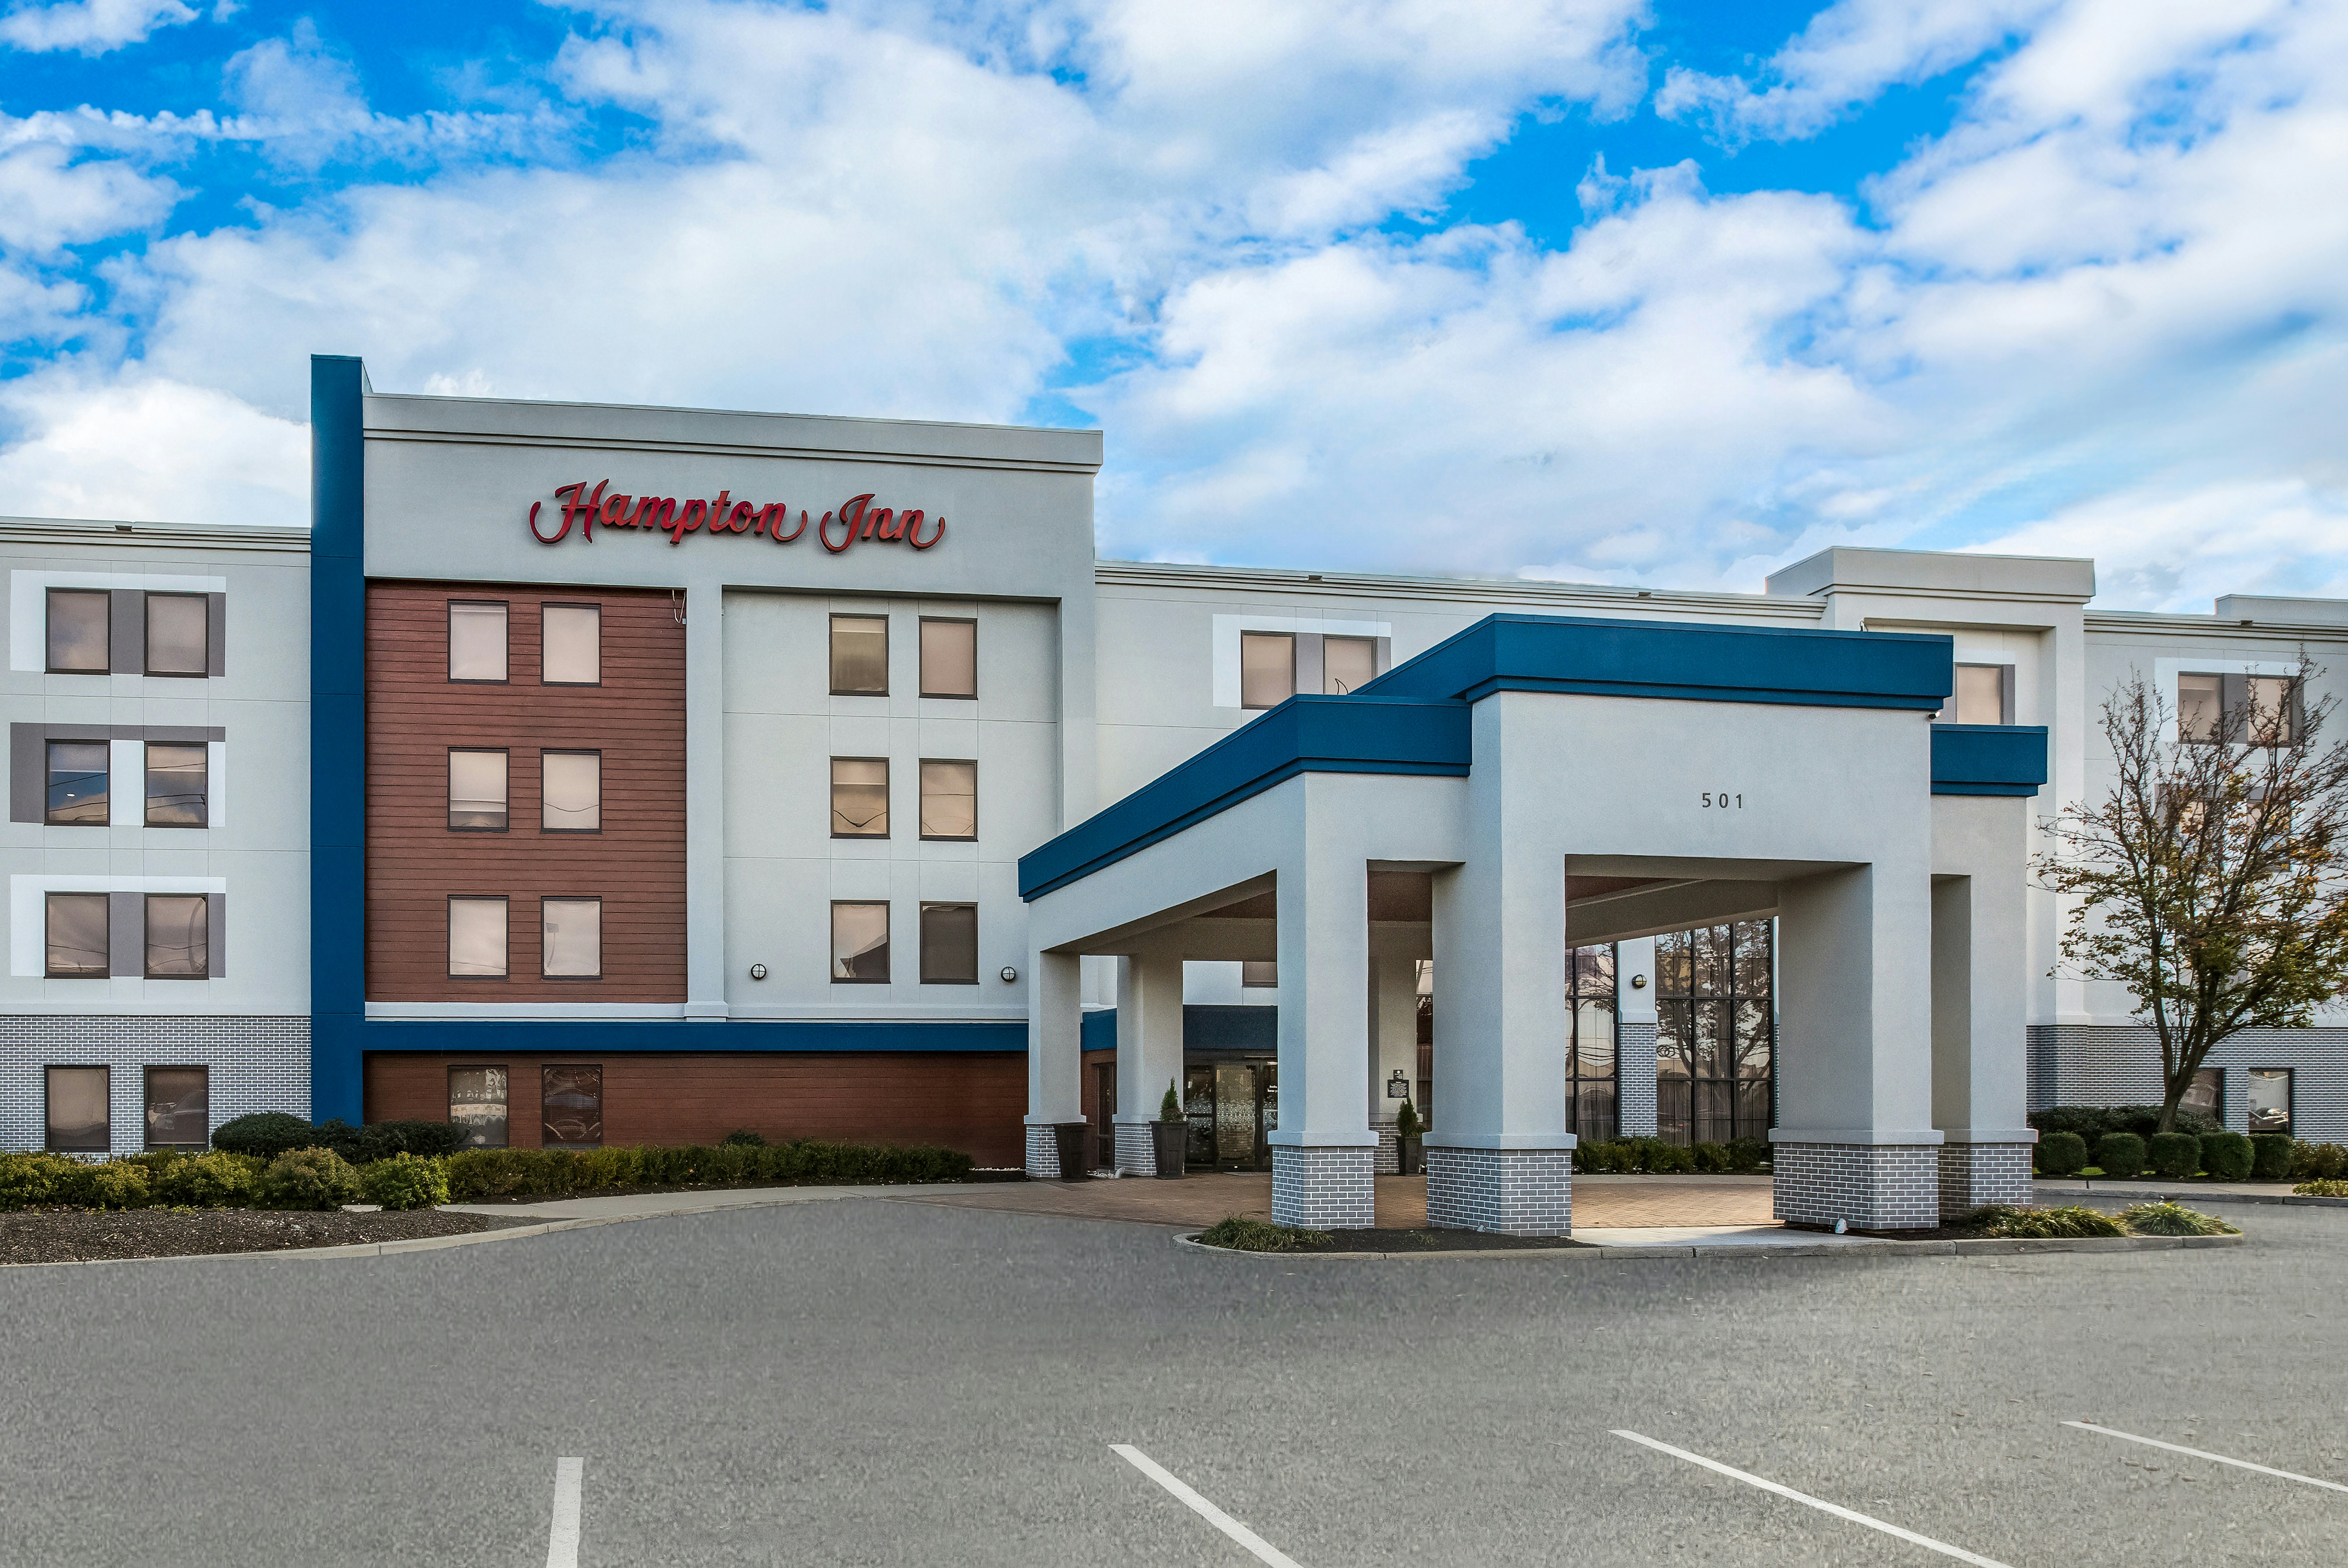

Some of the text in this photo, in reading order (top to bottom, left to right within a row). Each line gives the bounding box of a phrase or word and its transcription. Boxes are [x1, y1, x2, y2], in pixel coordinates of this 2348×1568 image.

[530, 479, 945, 553] Hampton Inn
[1702, 793, 1741, 808] 501
